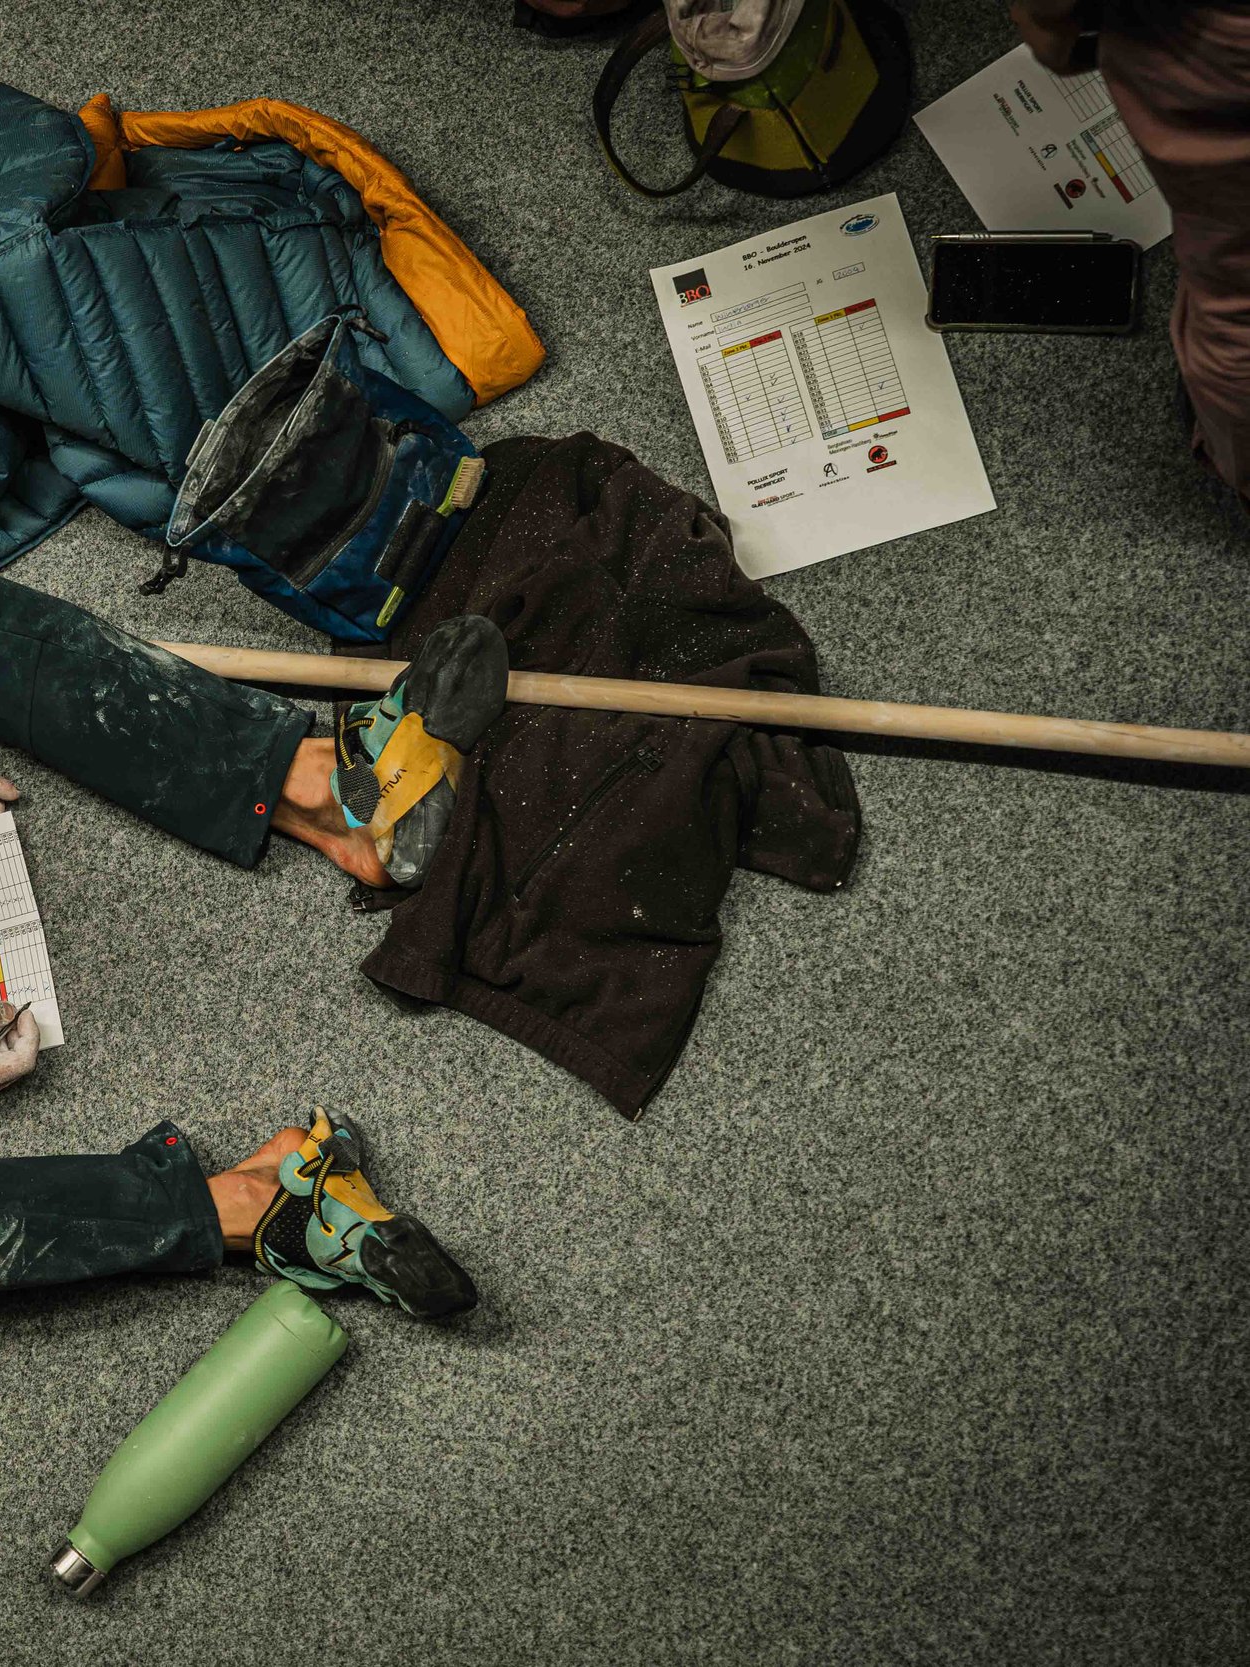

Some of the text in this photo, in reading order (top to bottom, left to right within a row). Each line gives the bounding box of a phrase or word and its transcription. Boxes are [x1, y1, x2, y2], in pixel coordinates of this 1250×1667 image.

[741, 233, 807, 261] BBO Boulderopen
[743, 242, 811, 271] 16. November 2024
[676, 283, 712, 305] BBO
[687, 319, 703, 329] Name
[690, 329, 715, 341] Vorname
[747, 468, 788, 486] POLLUX SPORT
